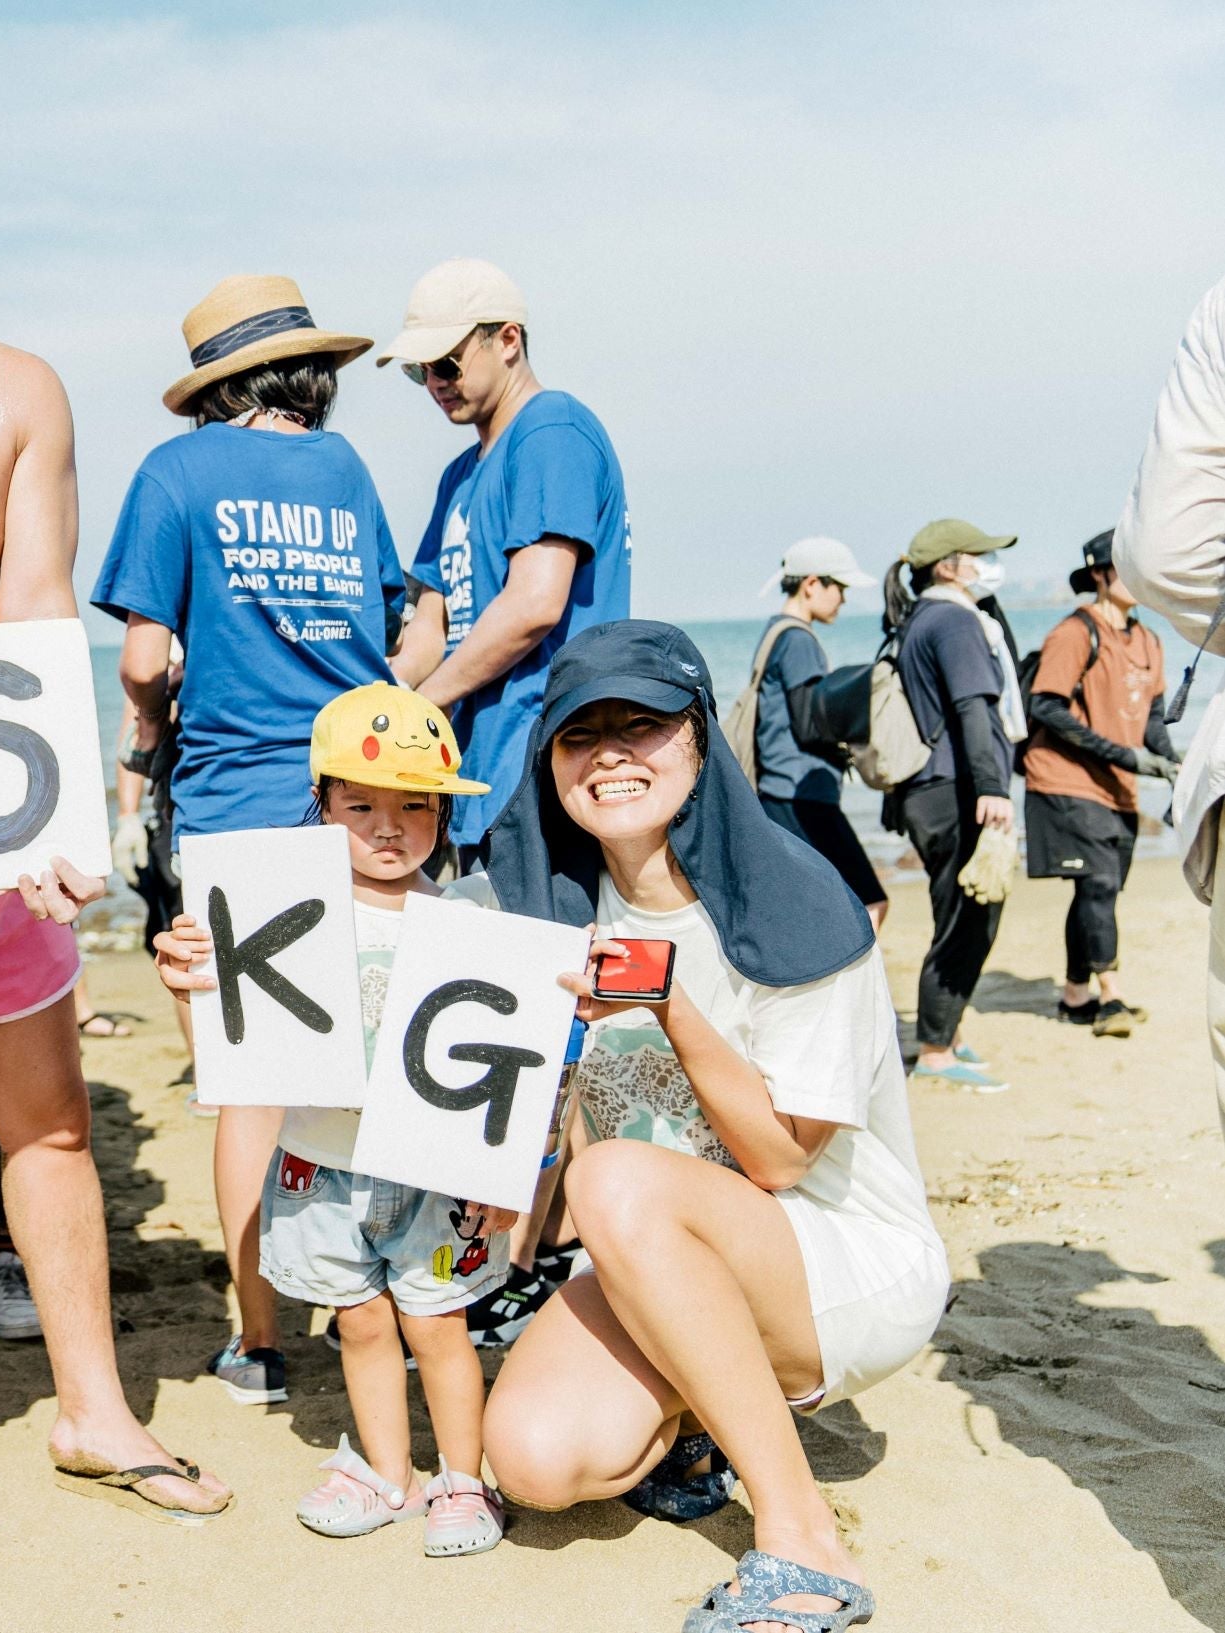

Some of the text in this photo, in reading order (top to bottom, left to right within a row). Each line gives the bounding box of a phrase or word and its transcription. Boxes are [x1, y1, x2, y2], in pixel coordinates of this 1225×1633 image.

[215, 499, 358, 551] STAND UP
[222, 547, 363, 577] FOR PEOPLE
[228, 572, 364, 597] AND THE EARTH
[208, 885, 334, 1045] K
[402, 978, 546, 1147] G
